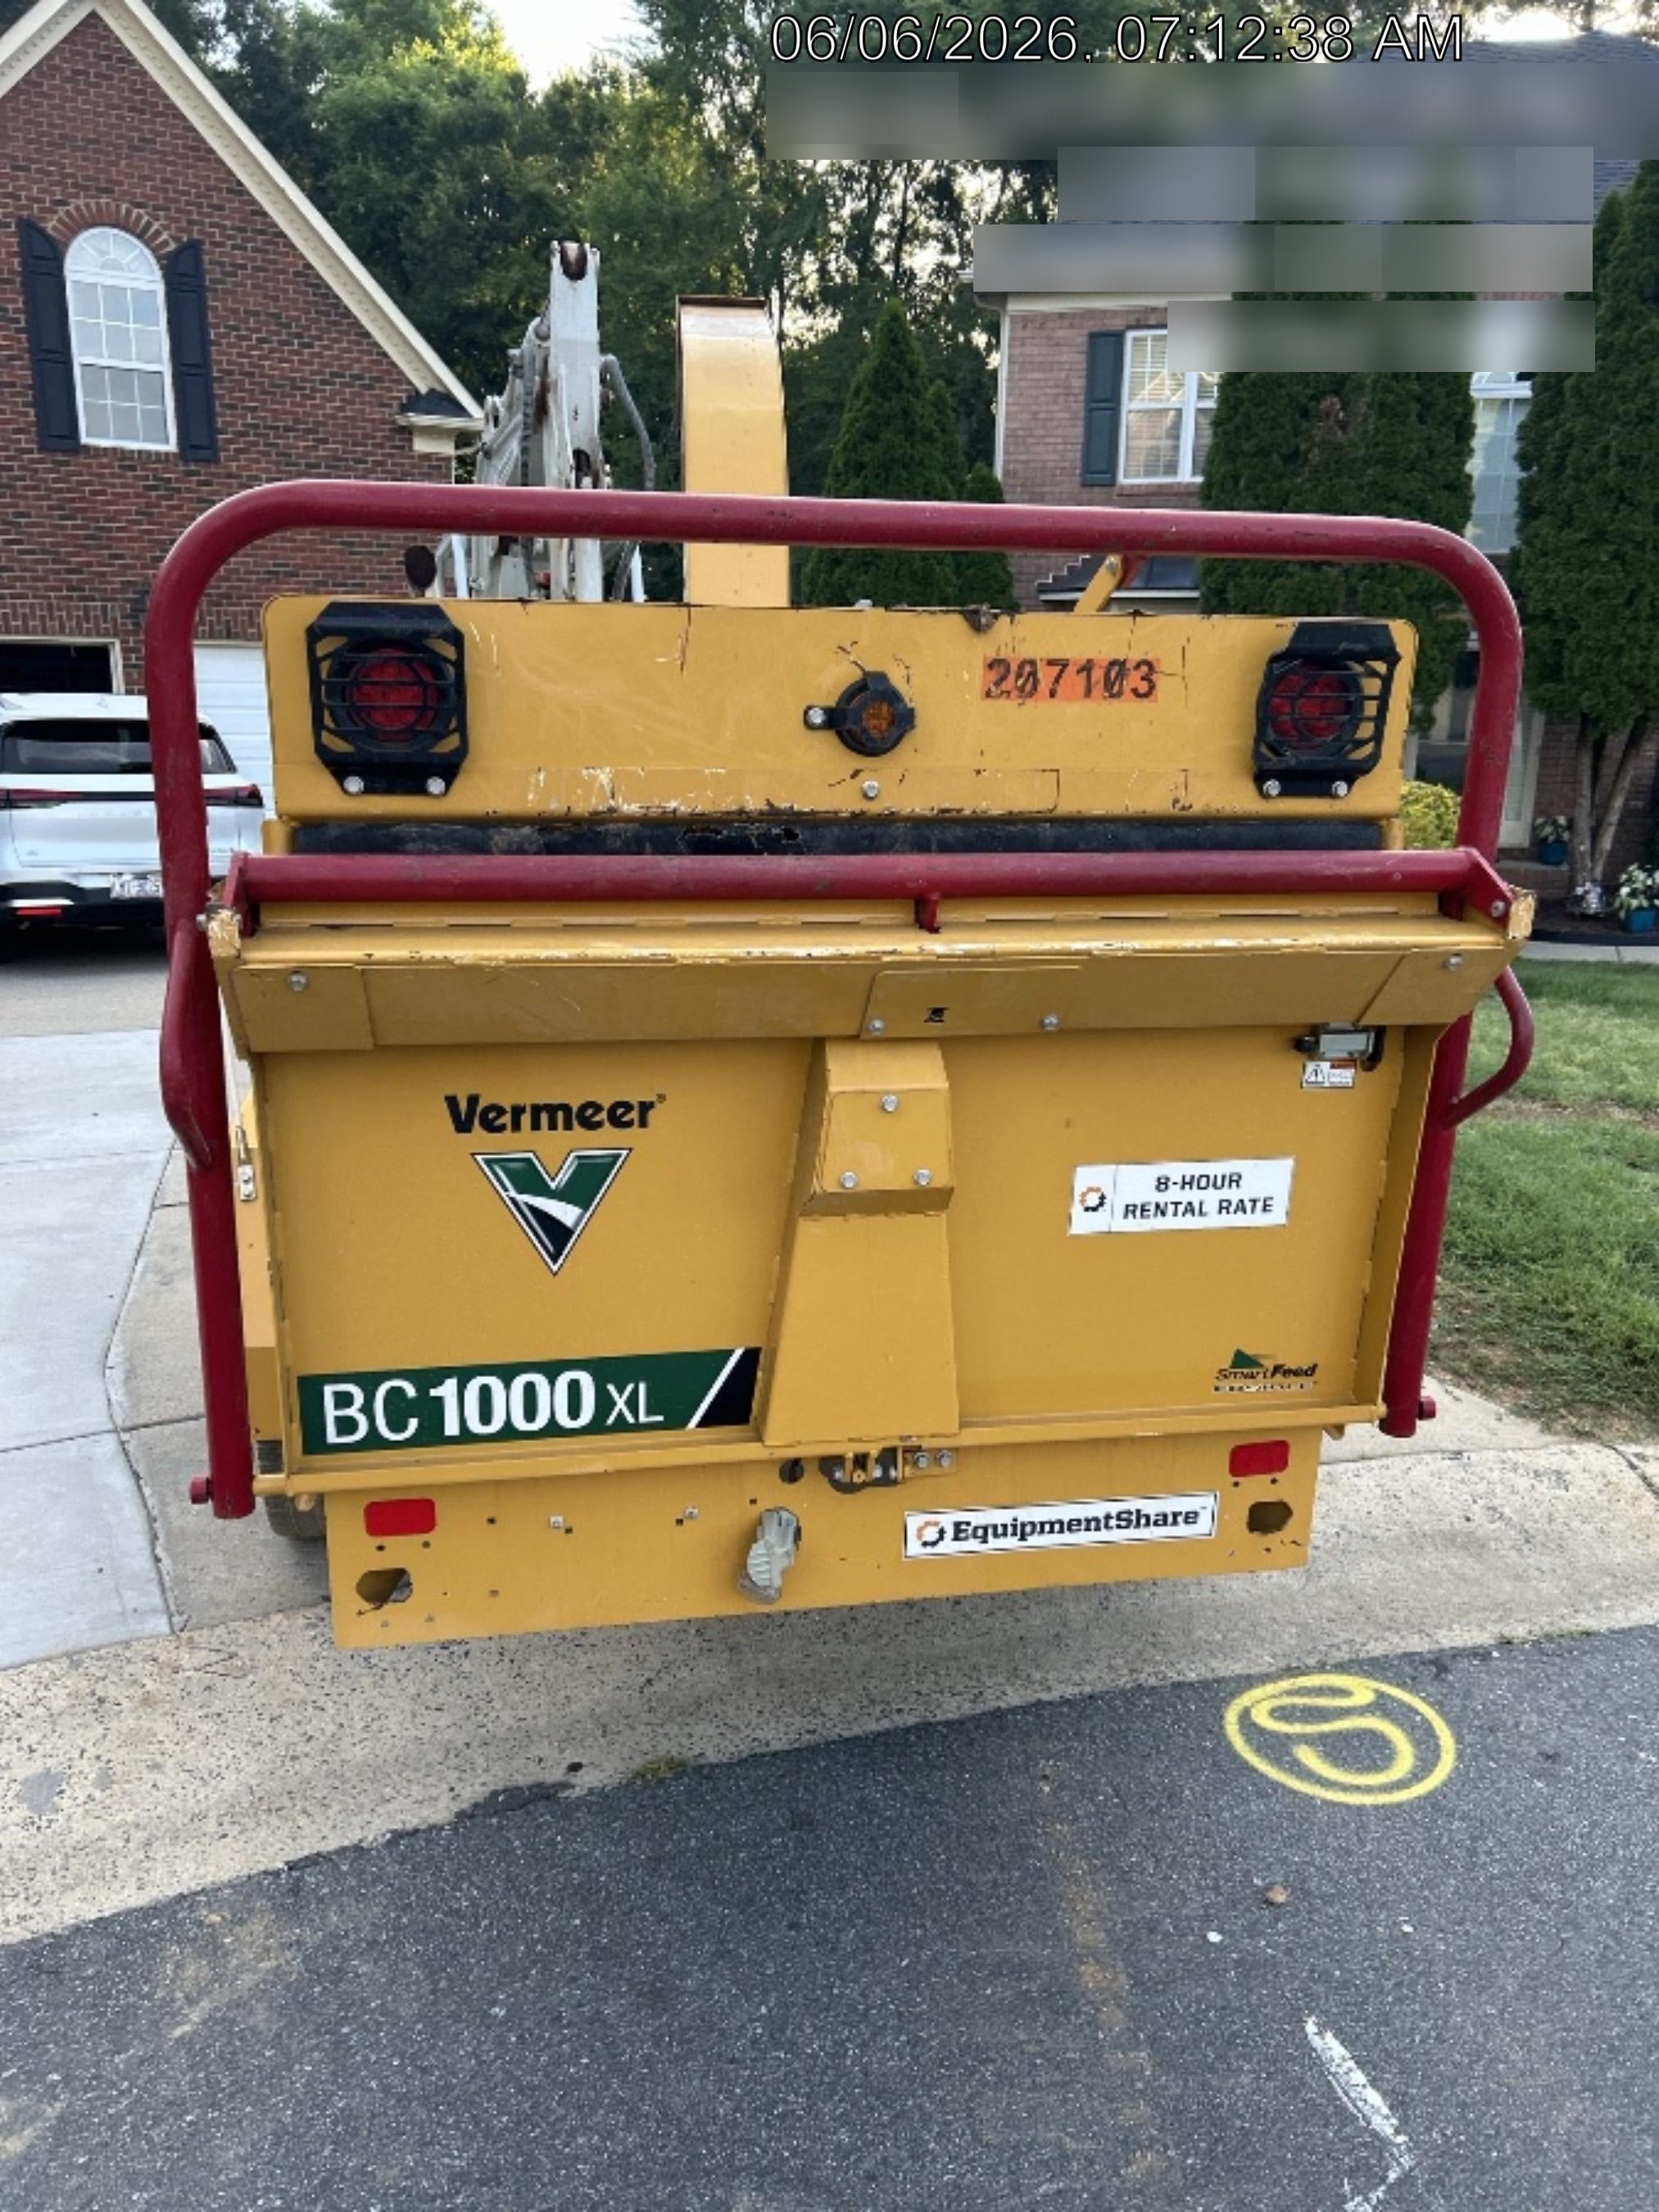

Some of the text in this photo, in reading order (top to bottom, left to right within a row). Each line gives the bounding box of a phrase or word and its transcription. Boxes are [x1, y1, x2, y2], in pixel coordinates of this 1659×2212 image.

[985, 657, 1158, 700] 207103
[1154, 1172, 1243, 1193] 8-HOUR
[1122, 1196, 1275, 1220] RENTAL RATE
[605, 1381, 665, 1427] XL
[951, 1509, 1201, 1544] EquipmentShare
